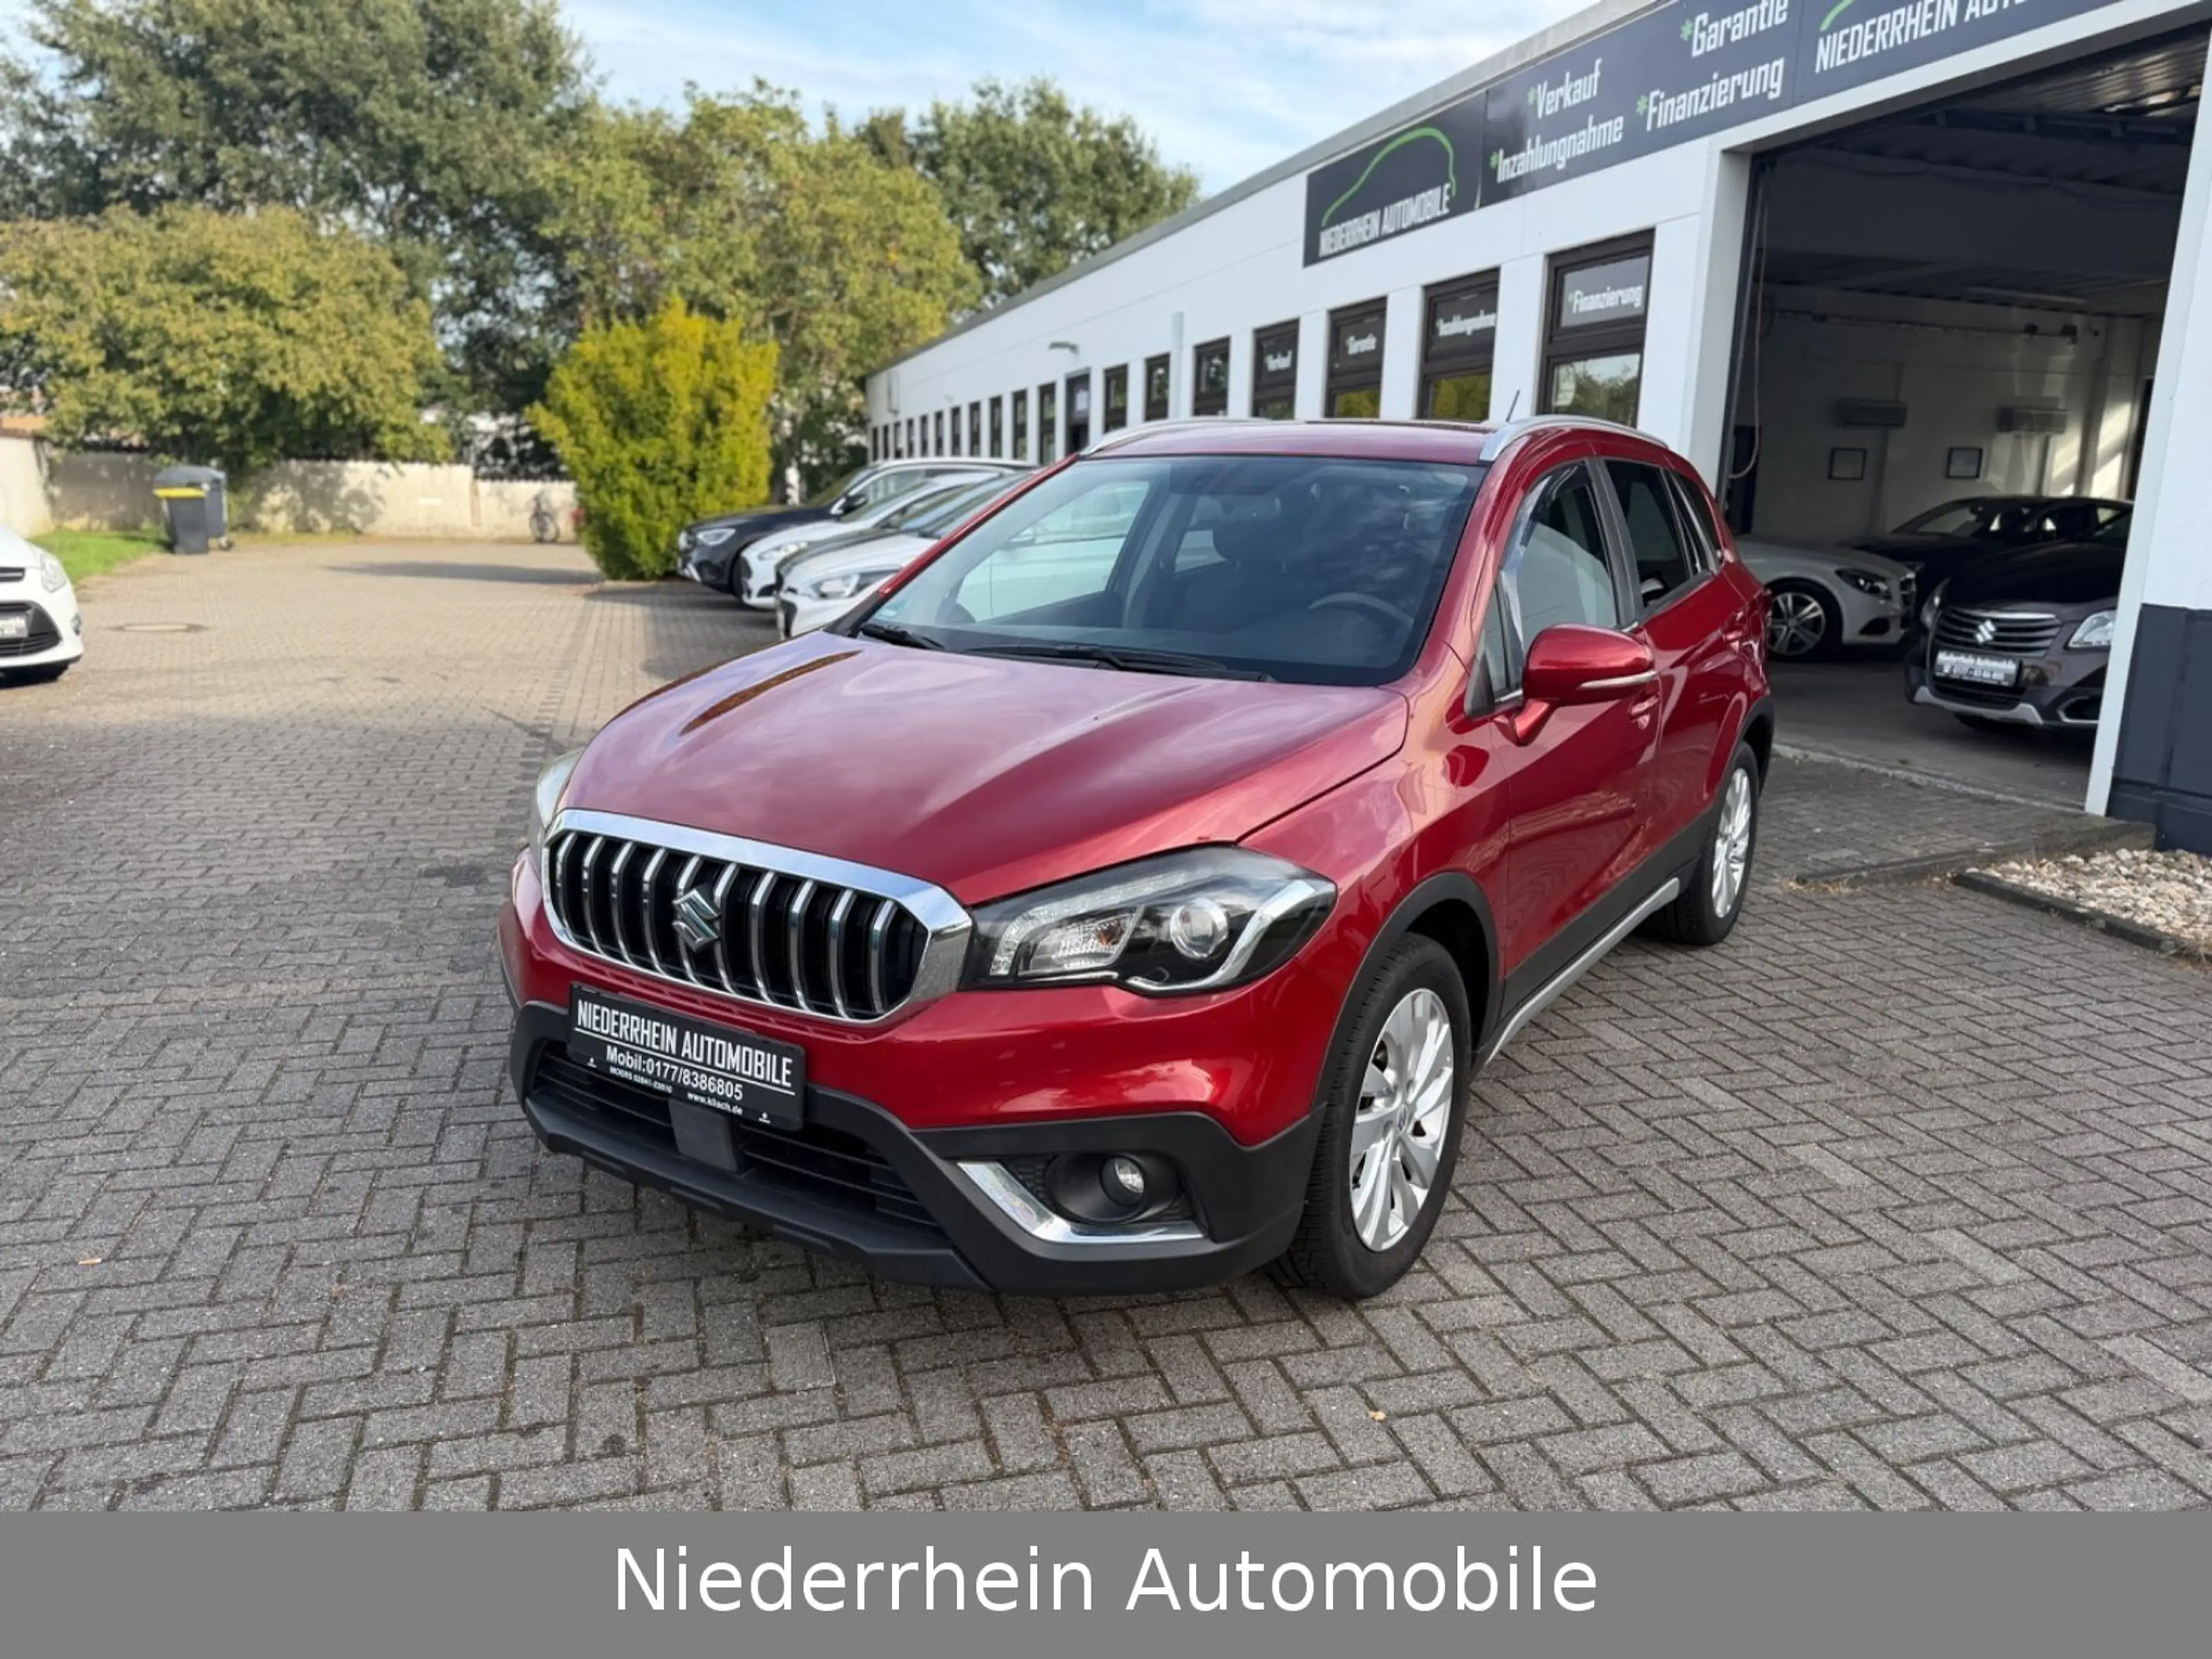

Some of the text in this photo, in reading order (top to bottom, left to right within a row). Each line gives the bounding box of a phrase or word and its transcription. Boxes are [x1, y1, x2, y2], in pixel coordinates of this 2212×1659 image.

[1691, 0, 1789, 58] Garantie
[1815, 0, 1959, 74] NIEDERRHEIN
[1537, 56, 1603, 120] Verkauf
[1646, 56, 1785, 132] Finanzierung
[1497, 113, 1624, 183] Inzahlungnahme
[577, 999, 792, 1088] NIEDERRHEIN AUTOMOBILE
[607, 1045, 743, 1101] Mobil:0177/8386805
